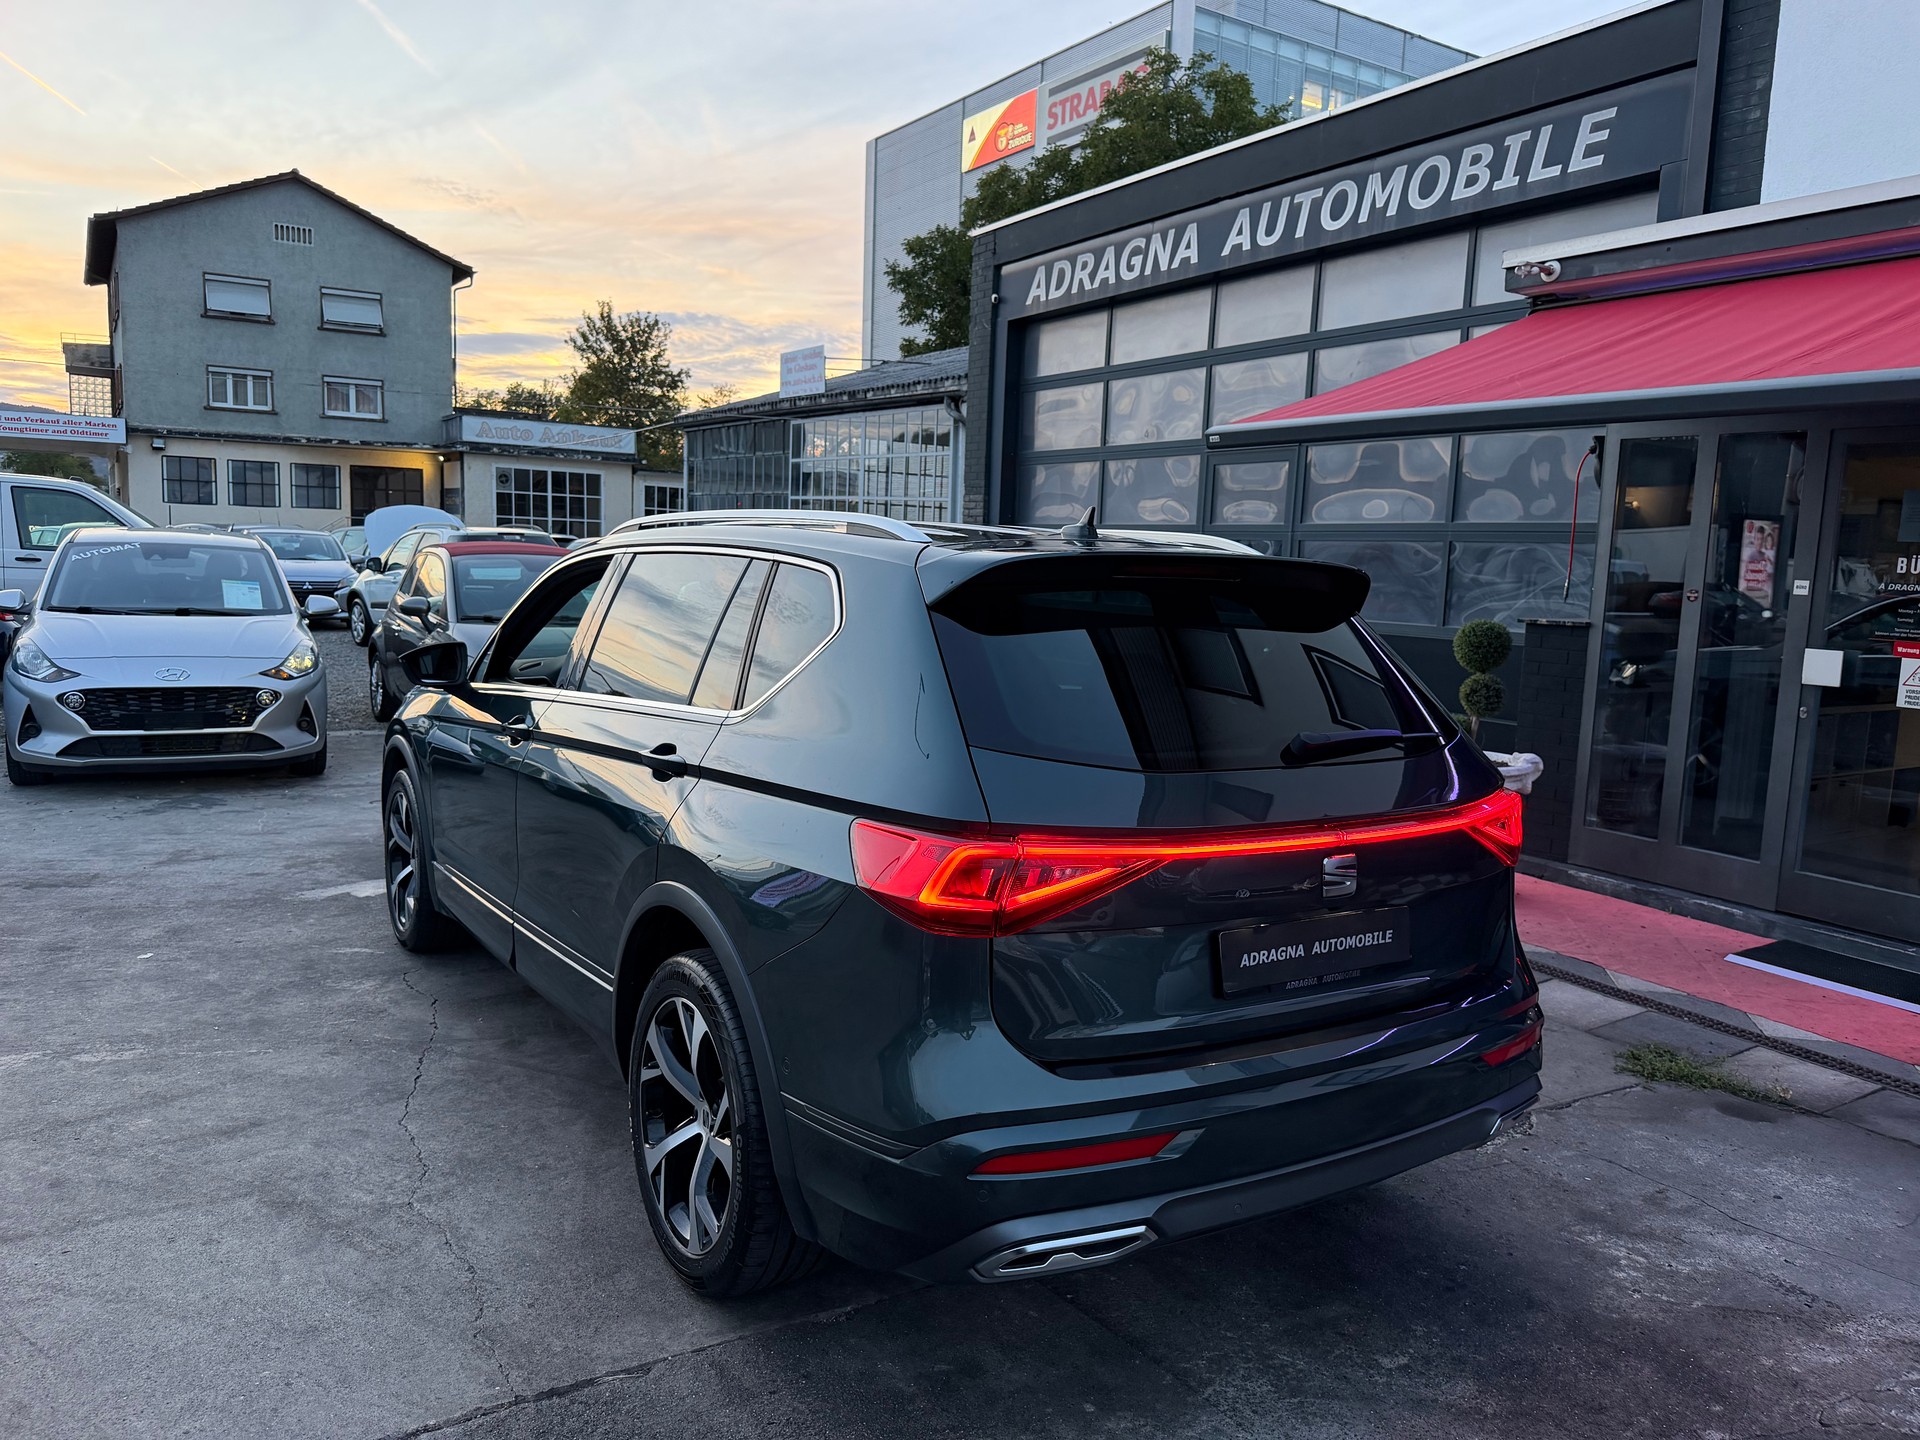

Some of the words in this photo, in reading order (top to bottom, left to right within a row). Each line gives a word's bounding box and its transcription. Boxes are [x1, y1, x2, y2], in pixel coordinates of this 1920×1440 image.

[1026, 222, 1199, 305] ADRAGNA
[1221, 106, 1618, 256] AUTOMOBILE
[24, 417, 60, 425] Verkauf
[85, 421, 117, 429] Marken
[70, 429, 109, 437] Oldtimer
[476, 422, 533, 441] Auto
[539, 427, 623, 448] Ankauf
[71, 541, 141, 562] AUTOMAT
[1897, 646, 1920, 654] Warnung
[1240, 943, 1305, 968] ADRAGNA
[1311, 929, 1393, 955] AUTOMOBILE
[1286, 977, 1318, 990] ADRAGNA
